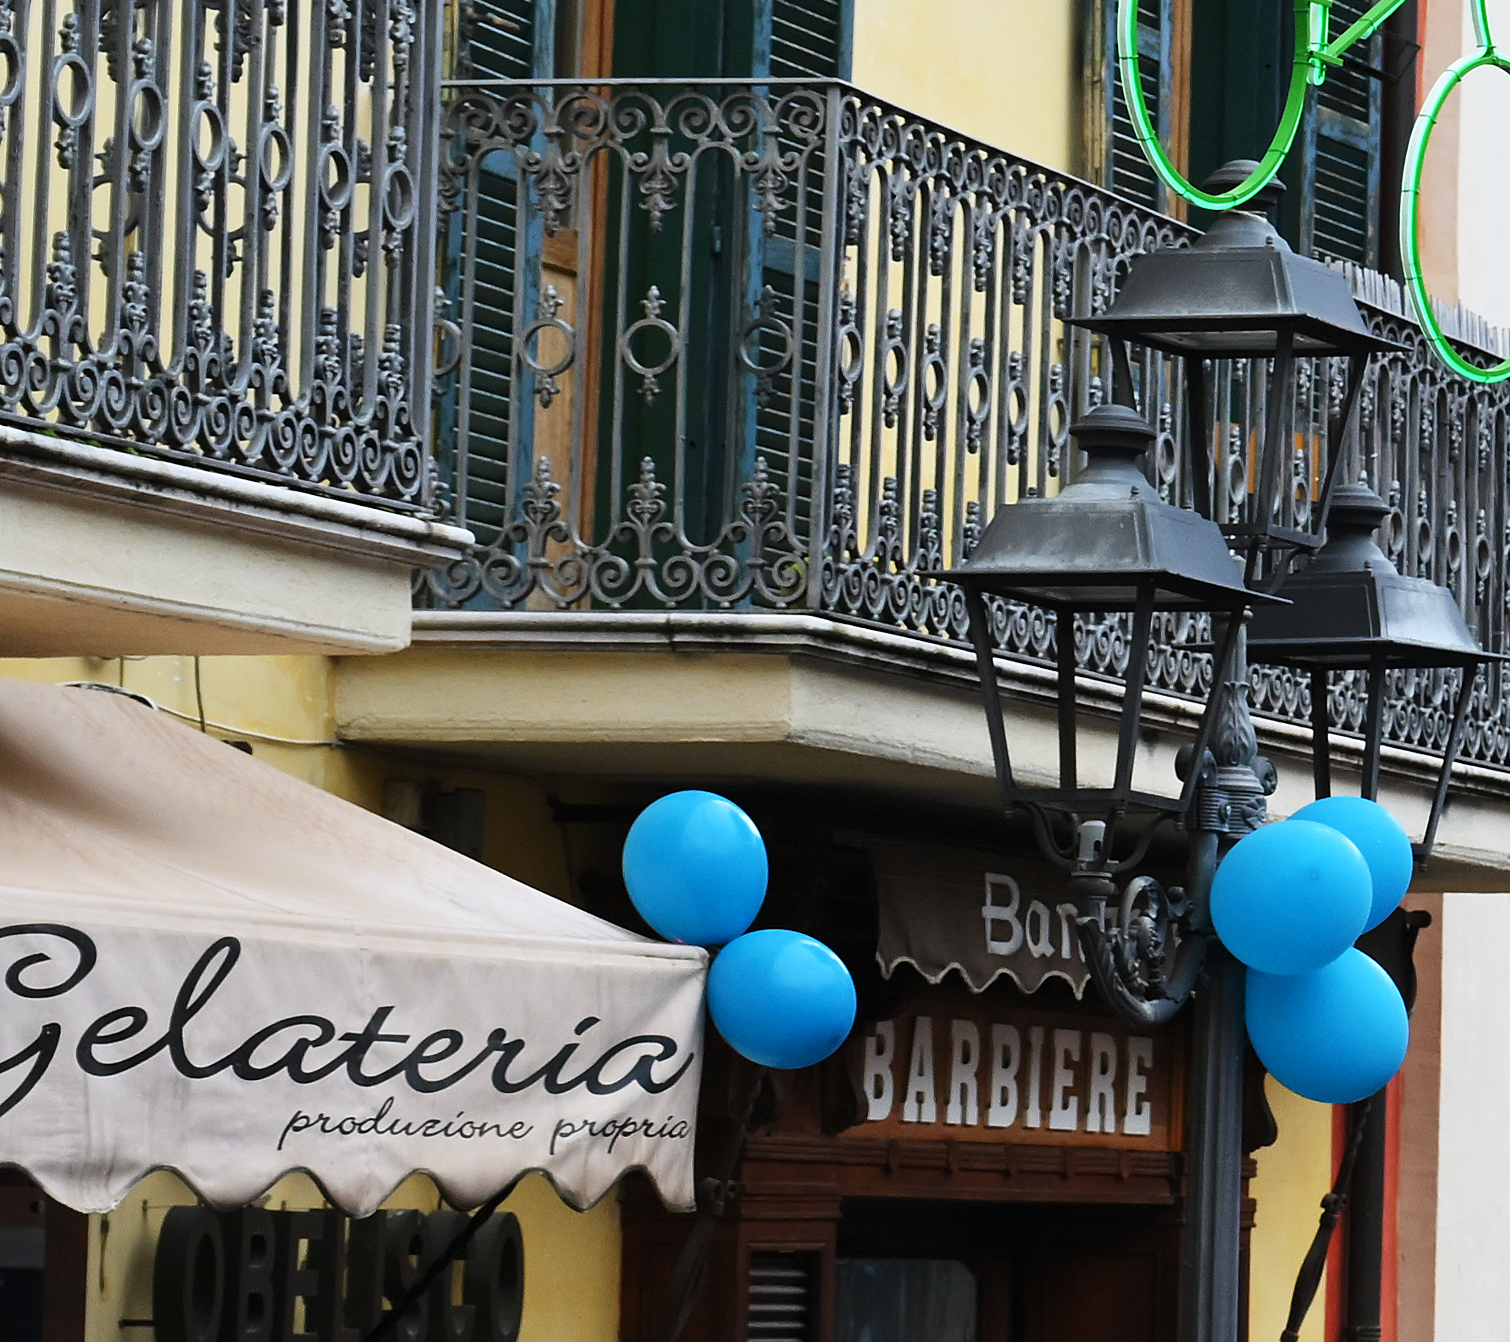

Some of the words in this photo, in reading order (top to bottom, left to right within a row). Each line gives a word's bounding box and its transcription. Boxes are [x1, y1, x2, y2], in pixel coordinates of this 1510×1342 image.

[864, 1015, 1154, 1136] BARBIERE
[279, 1097, 532, 1151] produzione
[550, 1107, 693, 1163] propria
